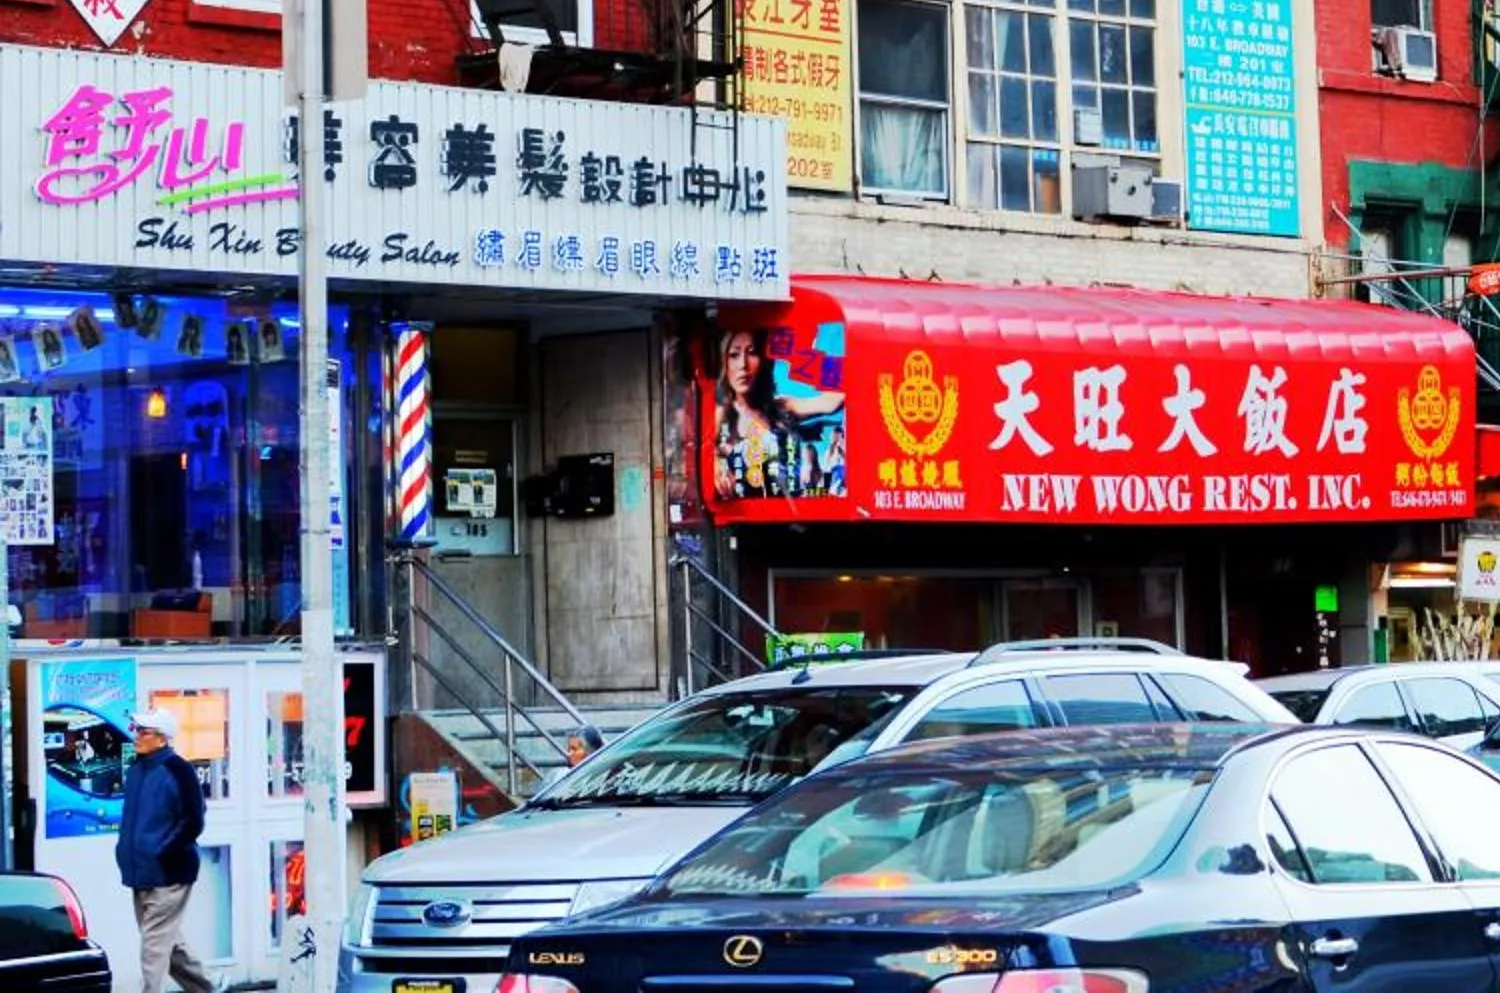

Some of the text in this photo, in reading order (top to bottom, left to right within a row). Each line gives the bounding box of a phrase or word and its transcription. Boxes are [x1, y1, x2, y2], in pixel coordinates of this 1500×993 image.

[136, 217, 195, 252] Shu
[209, 222, 264, 256] Xin
[380, 232, 462, 268] Salon
[988, 359, 1369, 459] 天旺大飯店
[1001, 473, 1083, 513] NEW
[1090, 473, 1193, 513] WONG
[1202, 473, 1298, 512] REST.
[1307, 473, 1372, 510] INC.
[529, 951, 585, 965] LEXUS
[954, 949, 997, 963] 300
